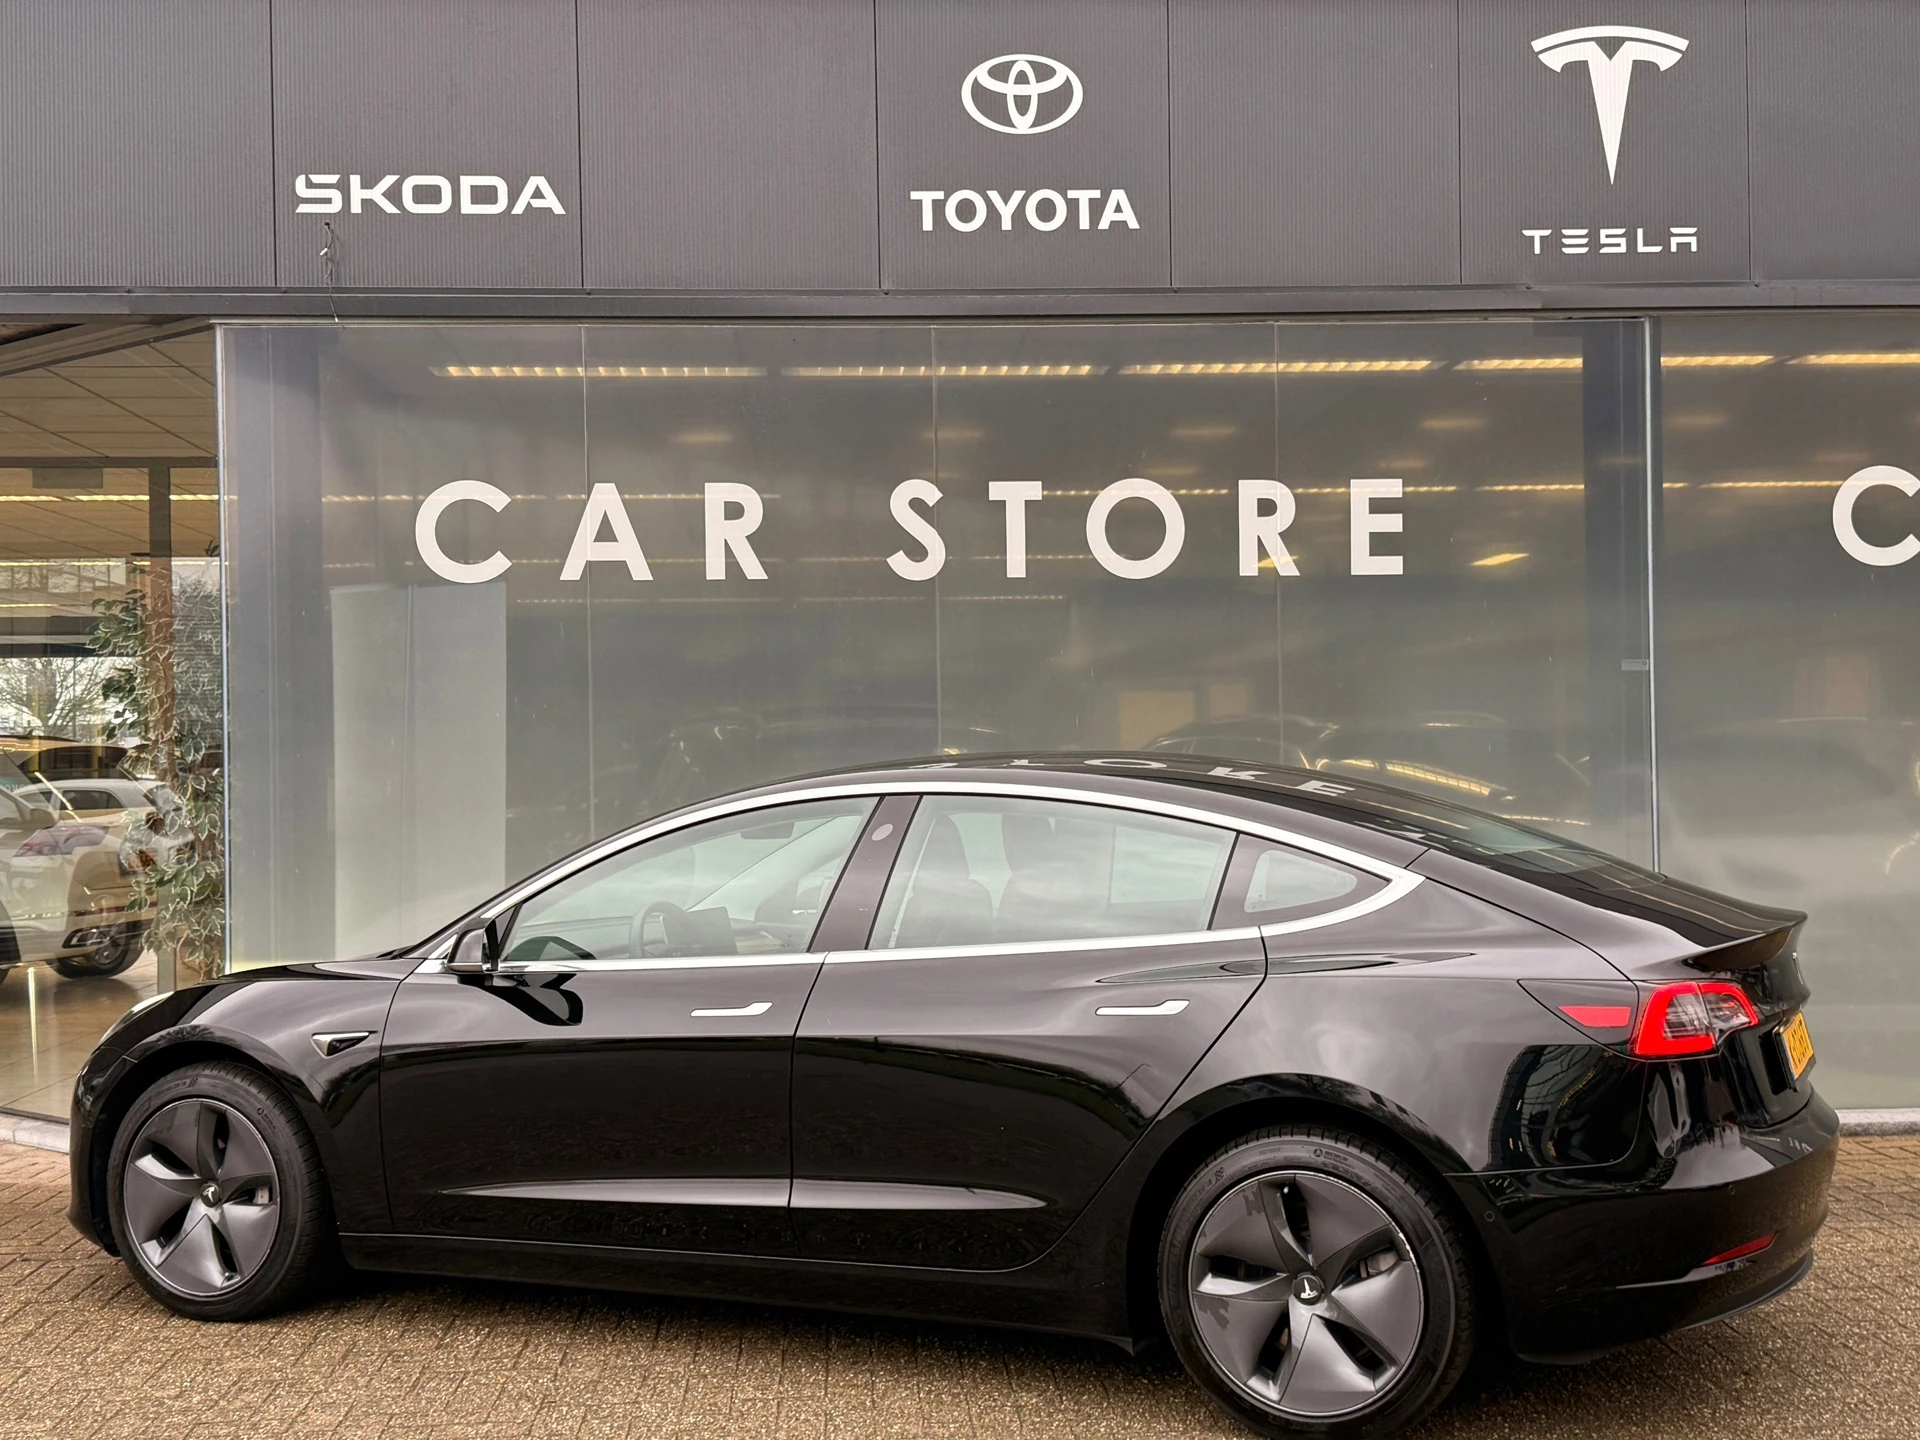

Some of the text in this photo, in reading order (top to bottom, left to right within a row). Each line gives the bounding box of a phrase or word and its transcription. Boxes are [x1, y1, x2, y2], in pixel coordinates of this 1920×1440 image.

[910, 189, 1140, 232] TOYOTA
[1522, 227, 1698, 254] TESLA
[415, 479, 1404, 583] CAR STORE
